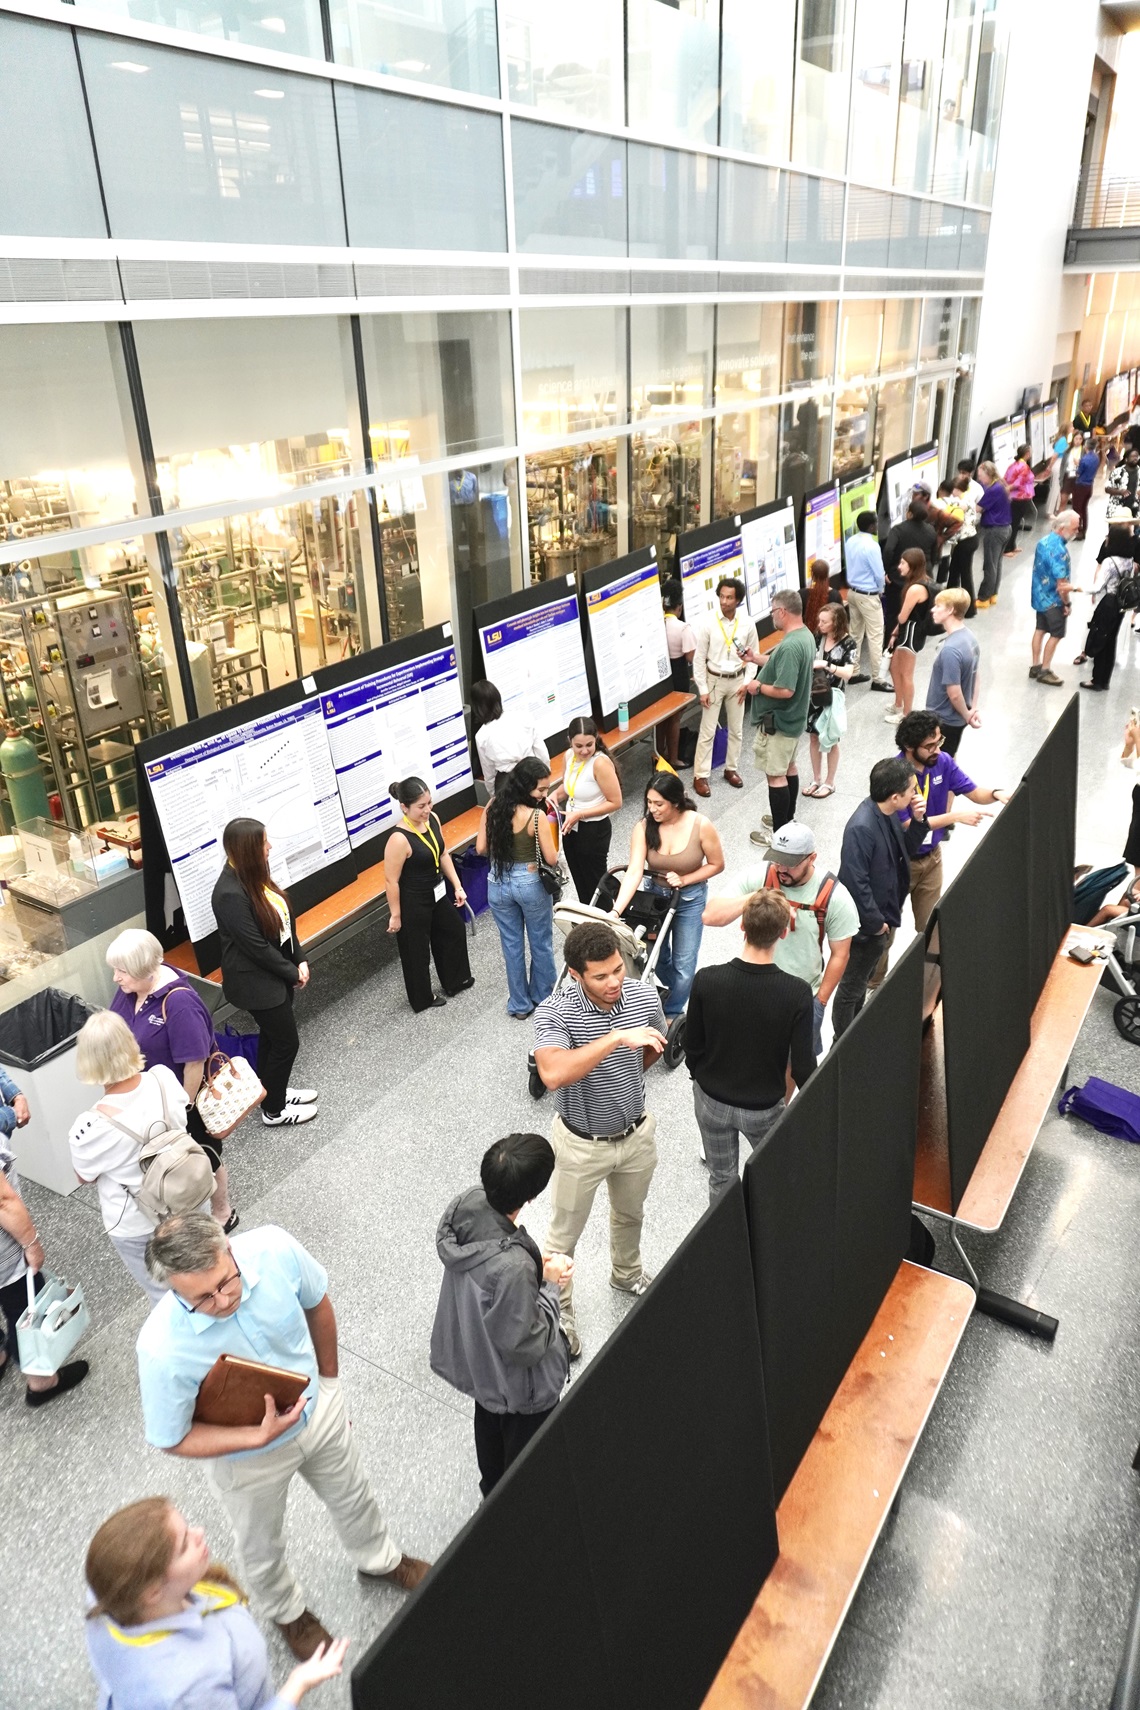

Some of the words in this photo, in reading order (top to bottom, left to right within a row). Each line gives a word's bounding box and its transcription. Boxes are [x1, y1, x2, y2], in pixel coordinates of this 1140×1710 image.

[717, 356, 750, 372] innovate
[538, 379, 572, 394] science
[573, 376, 590, 392] and
[487, 630, 503, 645] LSU
[147, 764, 164, 775] LSU
